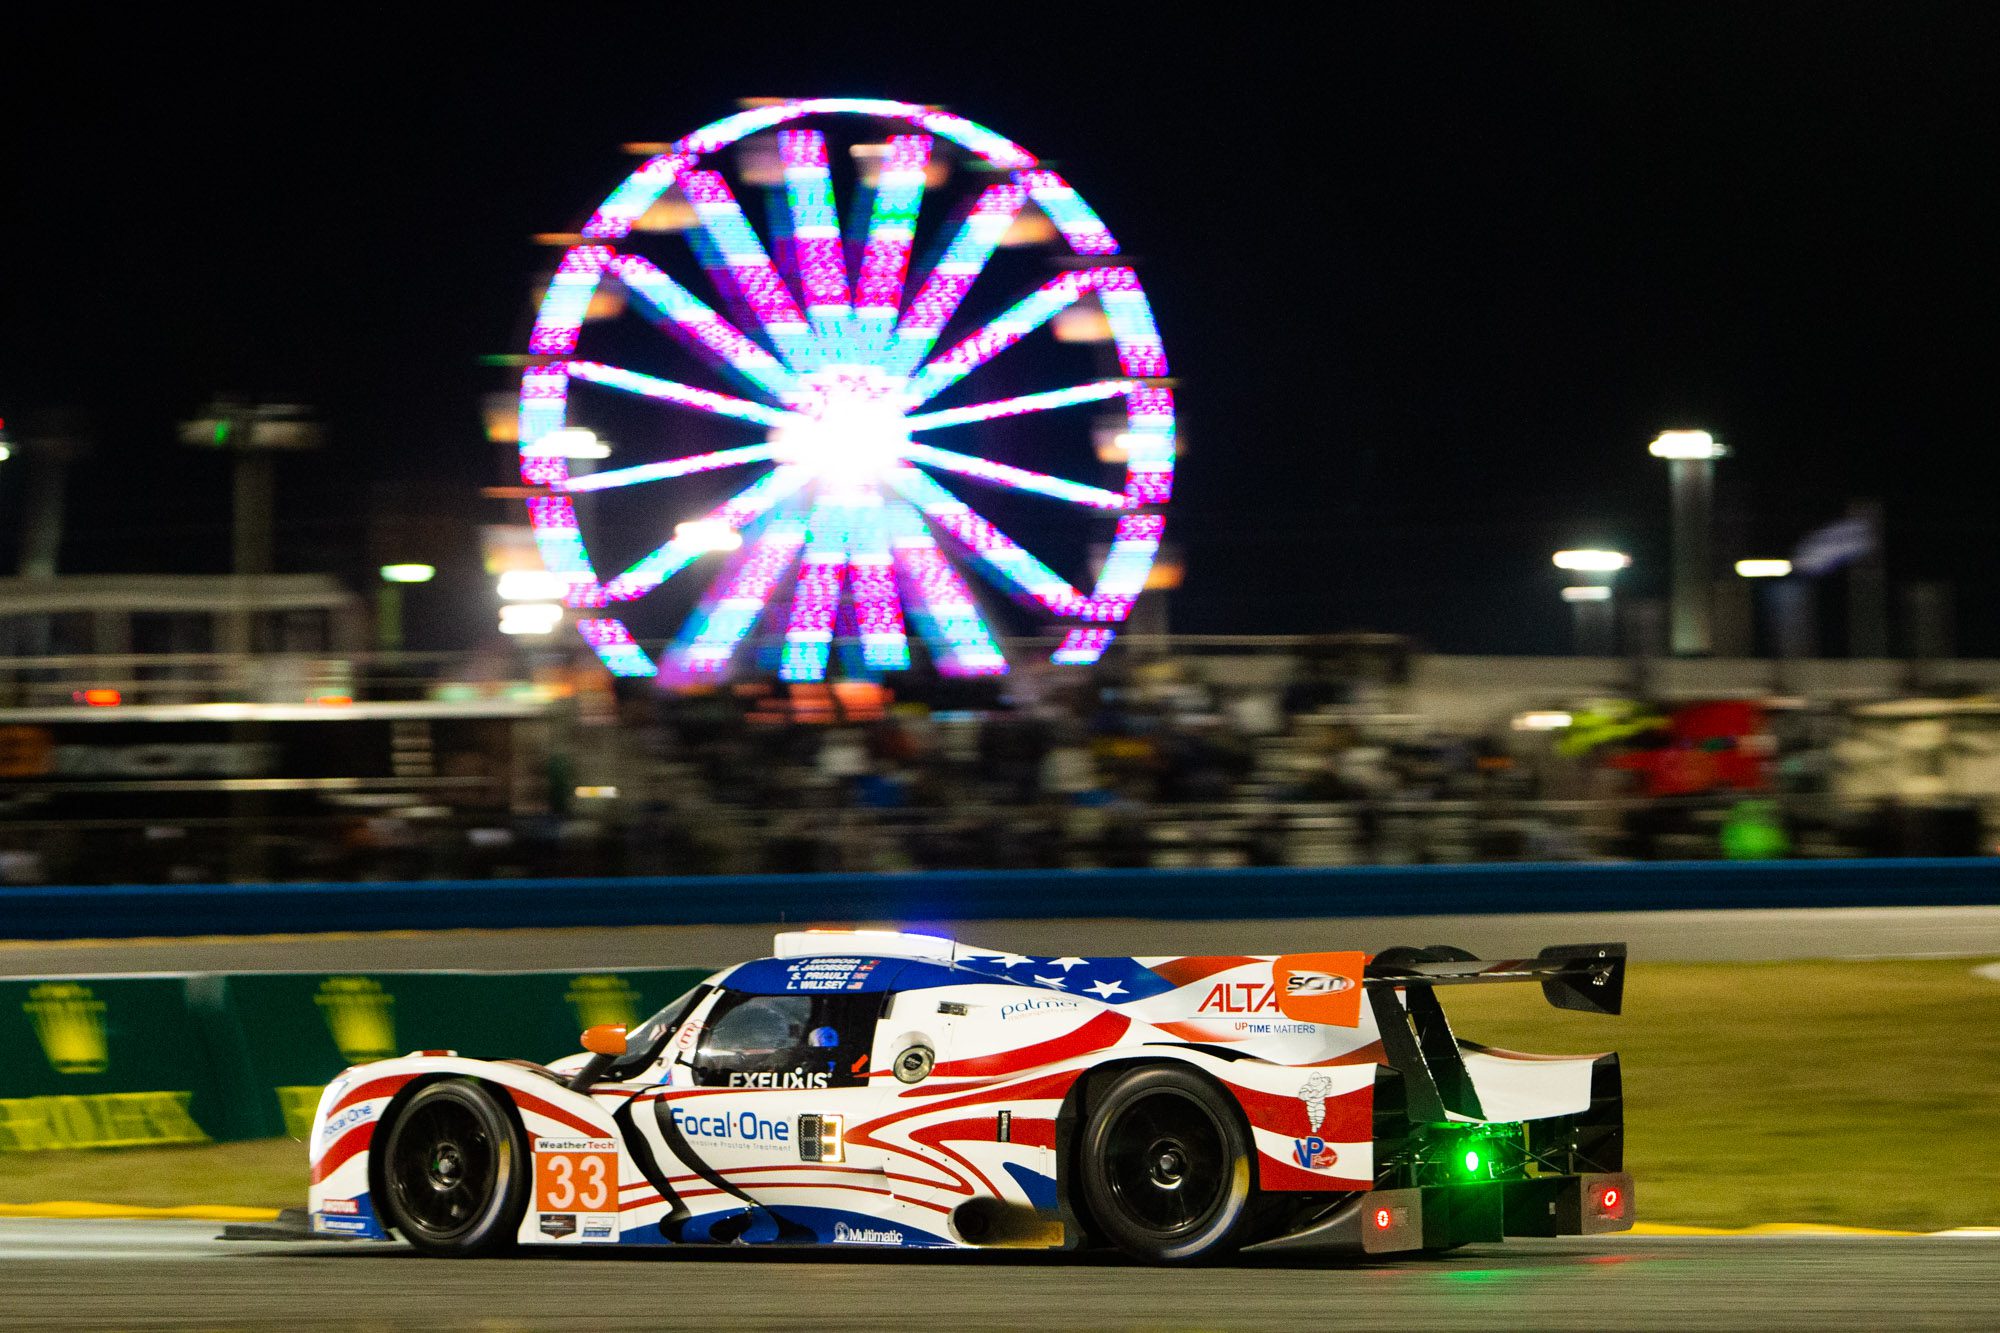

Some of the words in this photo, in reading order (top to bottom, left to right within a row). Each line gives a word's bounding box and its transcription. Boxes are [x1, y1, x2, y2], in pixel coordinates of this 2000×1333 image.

[804, 972, 851, 980] PRIAULX
[800, 981, 847, 990] WILLSEY
[1273, 1025, 1316, 1034] MATTERS
[540, 1141, 615, 1149] WeatherTech
[1295, 1137, 1324, 1168] VP
[547, 1155, 608, 1210] 33
[849, 1229, 904, 1243] Multimatic
